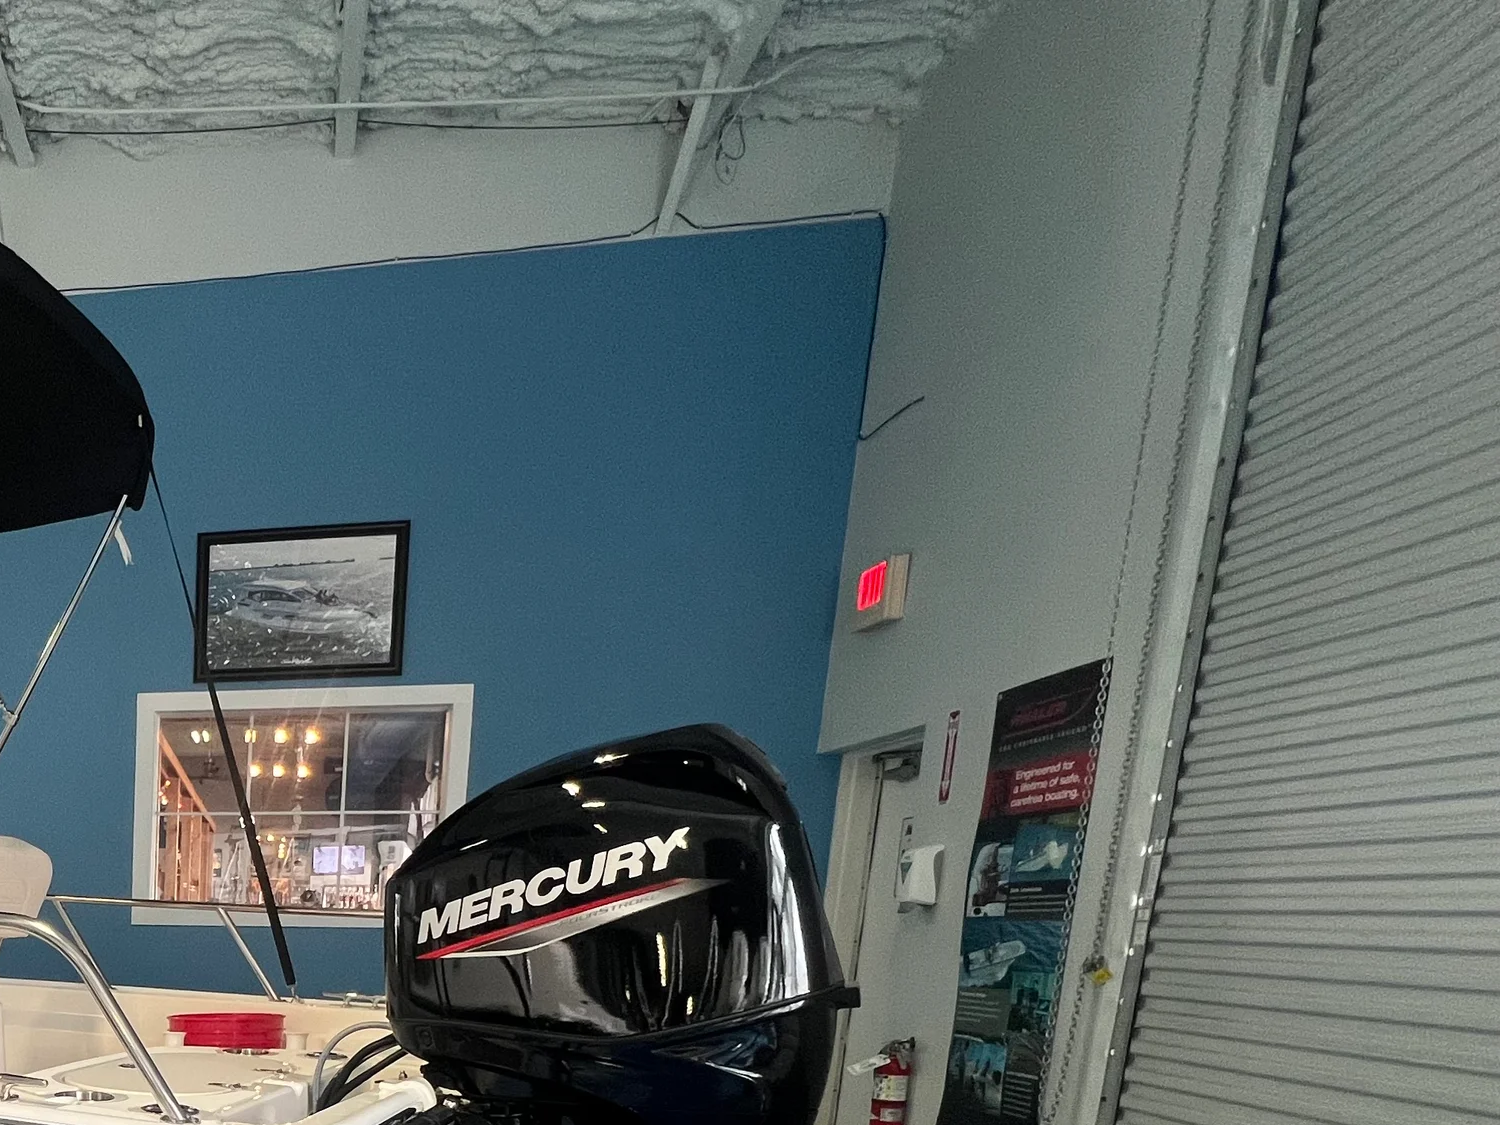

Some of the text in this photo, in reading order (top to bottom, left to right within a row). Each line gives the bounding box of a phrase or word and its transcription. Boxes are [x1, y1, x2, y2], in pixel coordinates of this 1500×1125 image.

[1015, 761, 1076, 780] Engineered for
[1048, 776, 1059, 787] of
[417, 826, 690, 944] MERCURY
